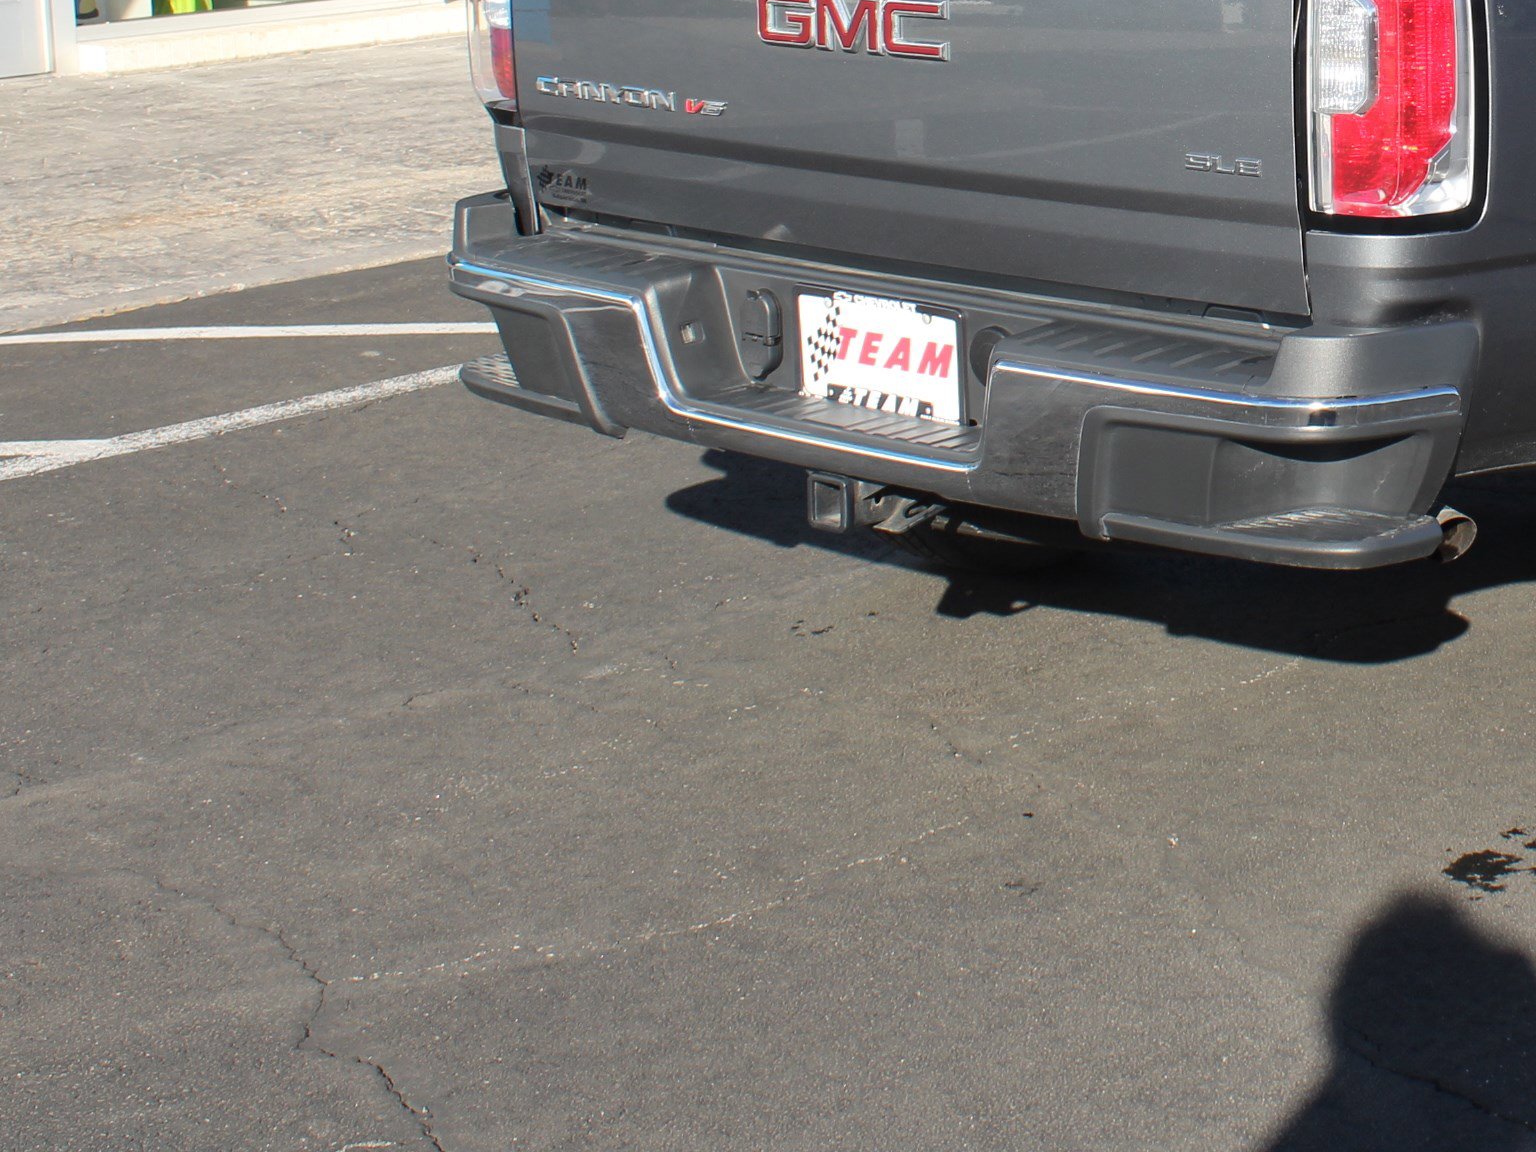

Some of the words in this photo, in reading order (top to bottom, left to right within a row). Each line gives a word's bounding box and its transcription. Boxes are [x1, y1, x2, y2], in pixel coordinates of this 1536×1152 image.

[535, 76, 676, 112] CANYON
[685, 97, 729, 116] V6
[1184, 152, 1262, 177] SLE
[837, 326, 954, 379] TEAM
